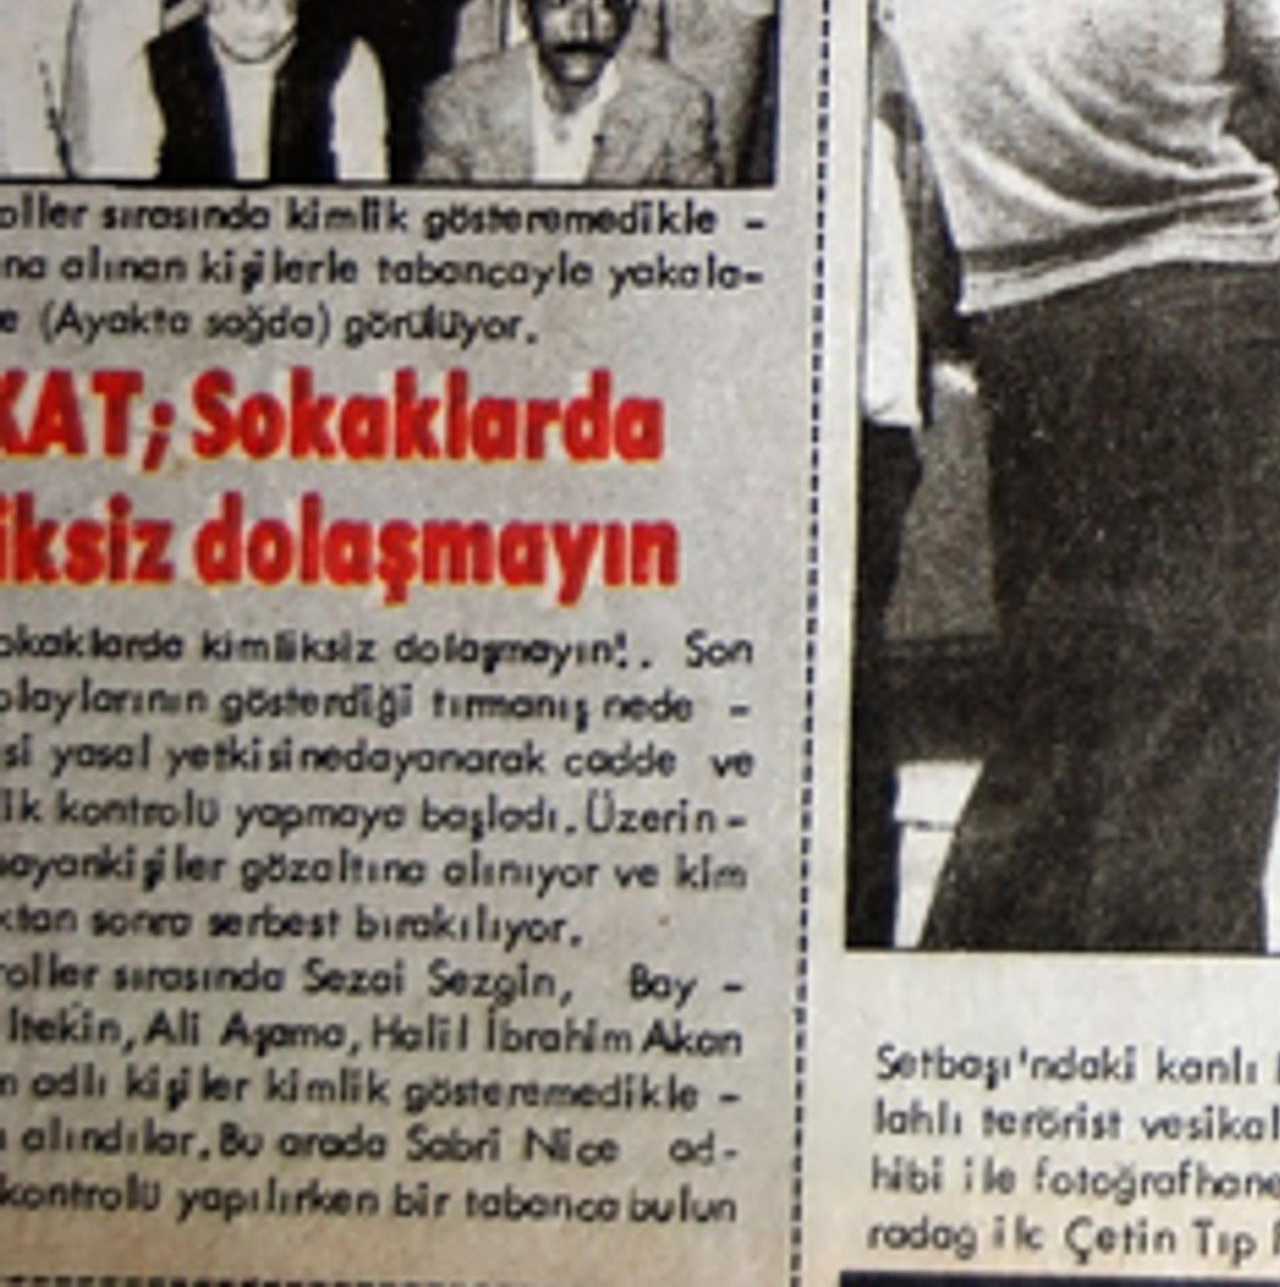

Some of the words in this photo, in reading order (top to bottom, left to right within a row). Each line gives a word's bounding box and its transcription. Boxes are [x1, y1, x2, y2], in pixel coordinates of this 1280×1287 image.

[99, 195, 271, 232] sırasında
[285, 195, 408, 233] kimlik
[58, 244, 188, 285] alınan
[197, 247, 358, 296] kişilerle
[376, 249, 593, 299] tabancayla
[38, 299, 191, 347] (Ayakta
[202, 302, 331, 347] sağda)
[191, 365, 663, 466] Sokaklarda
[192, 490, 679, 609] dolaşmayın
[197, 629, 377, 664] kimliksiz
[684, 628, 754, 669] Son
[219, 682, 413, 729] gösterdiği
[431, 689, 590, 734] tırmanış
[49, 732, 151, 780] yasal
[562, 740, 677, 779] cadde
[709, 752, 755, 779] ve
[52, 788, 220, 829] kontrolü
[234, 802, 407, 841] yapmaya
[238, 846, 426, 894] gözaltına
[441, 848, 601, 901] alınıyor
[613, 863, 659, 890] ve
[673, 852, 747, 892] kim
[90, 909, 192, 939] sonra
[206, 903, 341, 941] serbest
[353, 903, 582, 955] bırakılıyor.
[111, 958, 284, 994] sırasında
[302, 956, 404, 998] Sezai
[427, 957, 573, 1007] Sezgin,
[625, 962, 698, 1011] Bay
[487, 1006, 633, 1055] İbrahim
[640, 1018, 742, 1059] Akan
[28, 1062, 107, 1102] adlı
[124, 1063, 251, 1114] kişiler
[262, 1066, 390, 1106] kimlik
[1155, 1045, 1257, 1086] kanlı
[272, 1123, 388, 1162] arada
[405, 1122, 501, 1164] Sabri
[873, 1097, 962, 1137] lahlı
[981, 1102, 1122, 1141] terörist
[173, 1175, 380, 1227] yapılırken
[389, 1181, 451, 1220] bir
[464, 1183, 621, 1224] tabanca
[870, 1154, 943, 1196] hibi
[964, 1156, 1016, 1196] ile
[1063, 1215, 1177, 1267] Çetin
[1191, 1217, 1257, 1270] Tıp
